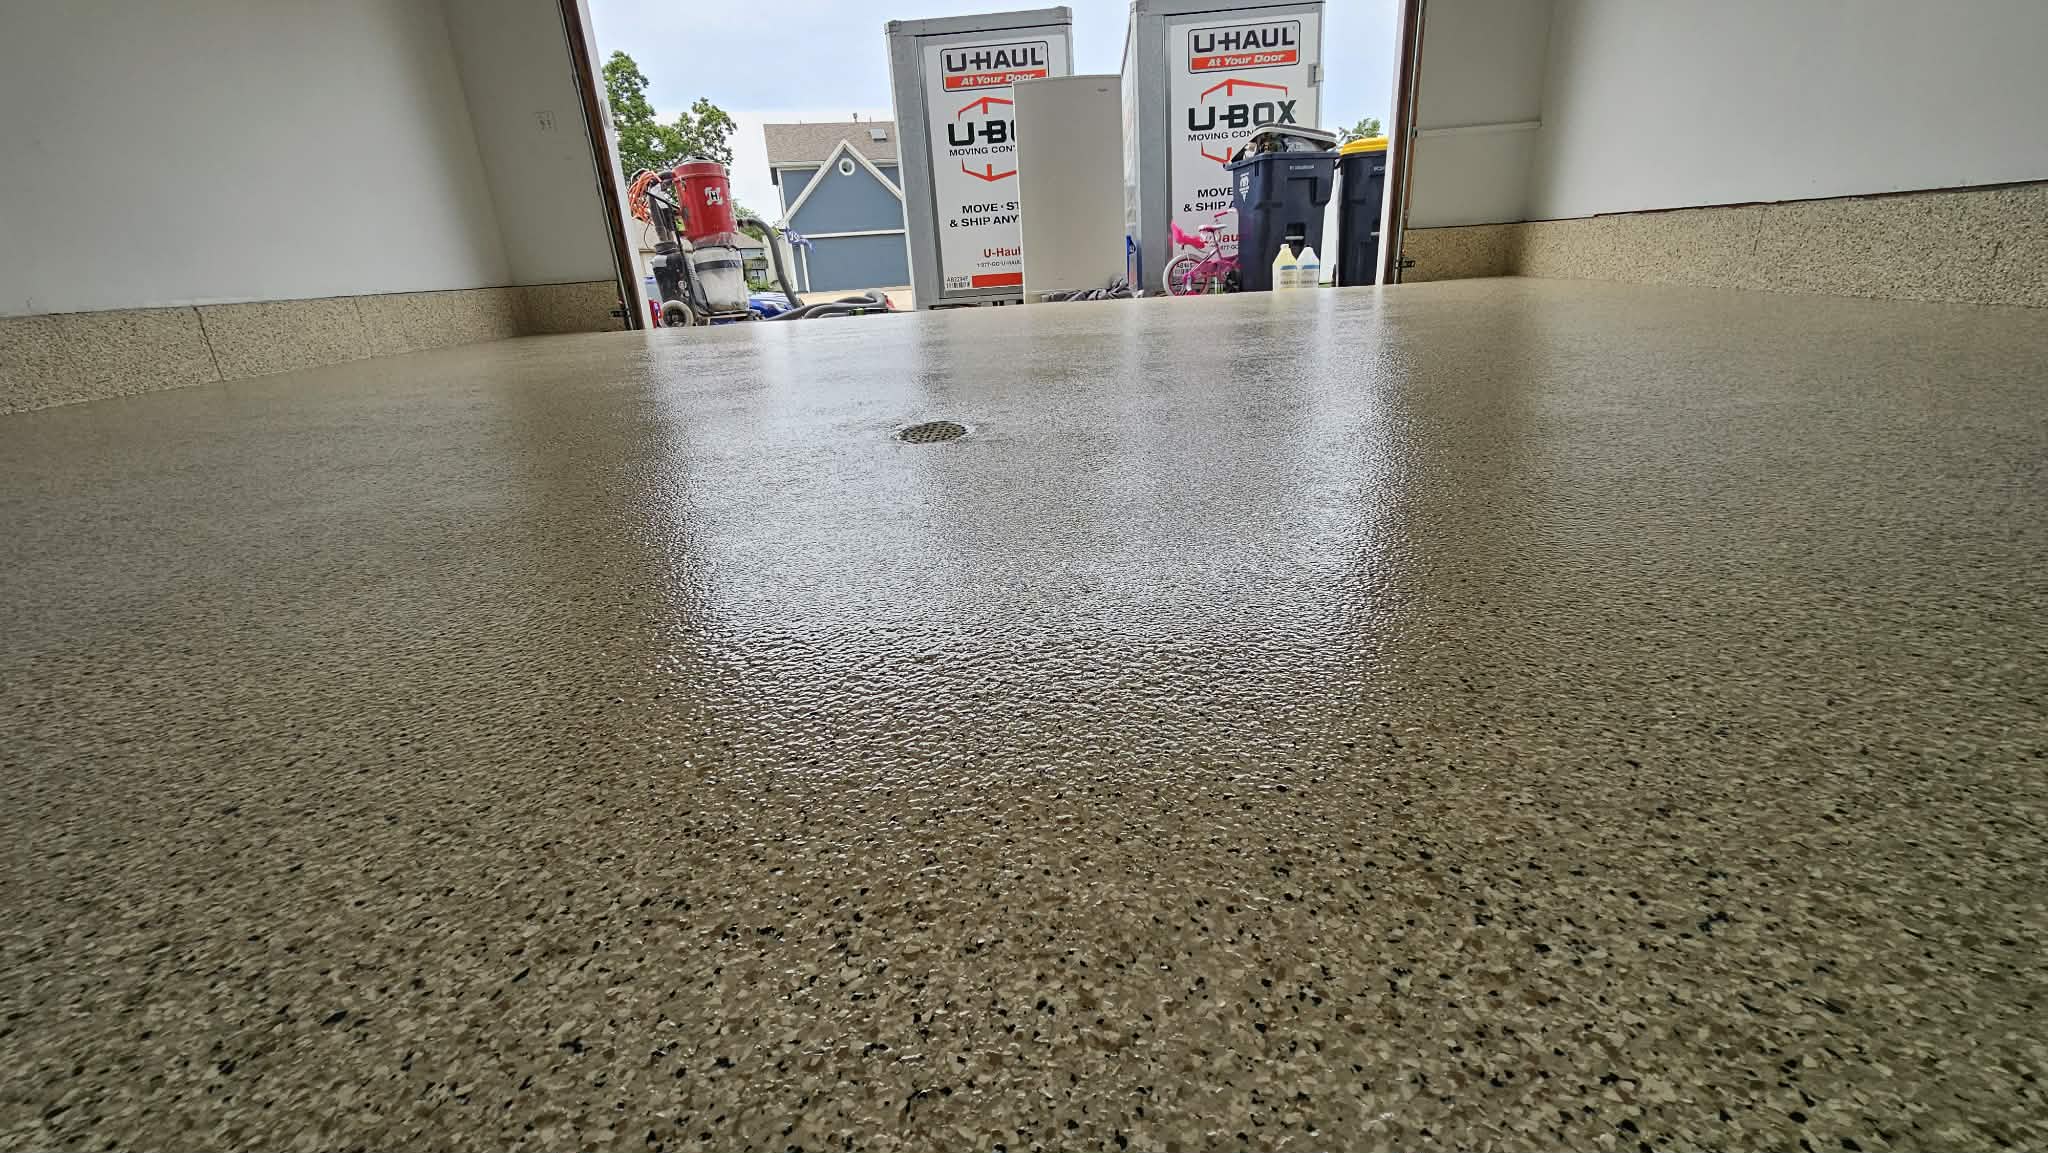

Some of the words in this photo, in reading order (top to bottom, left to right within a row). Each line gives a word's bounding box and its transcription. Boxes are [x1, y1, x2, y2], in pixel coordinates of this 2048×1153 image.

[1193, 27, 1295, 53] U-HAUL
[946, 47, 1044, 72] U-HAUL
[1207, 58, 1221, 67] At
[1223, 55, 1251, 66] Your
[1254, 53, 1285, 63] Door
[960, 78, 974, 86] At
[977, 75, 1003, 85] Your
[1188, 100, 1297, 131] U-BOX
[947, 119, 1016, 147] U-B
[1188, 132, 1229, 142] MOVING
[1231, 130, 1254, 139] CON
[949, 147, 989, 157] MOVING
[991, 145, 1016, 154] CON
[962, 203, 998, 214] MOVE
[1006, 201, 1019, 211] ST
[1183, 203, 1192, 212] &
[1195, 201, 1226, 212] SHIP
[949, 219, 958, 228] &
[961, 217, 991, 227] SHIP
[993, 215, 1019, 225] ANY
[983, 246, 1021, 258] U-Haul
